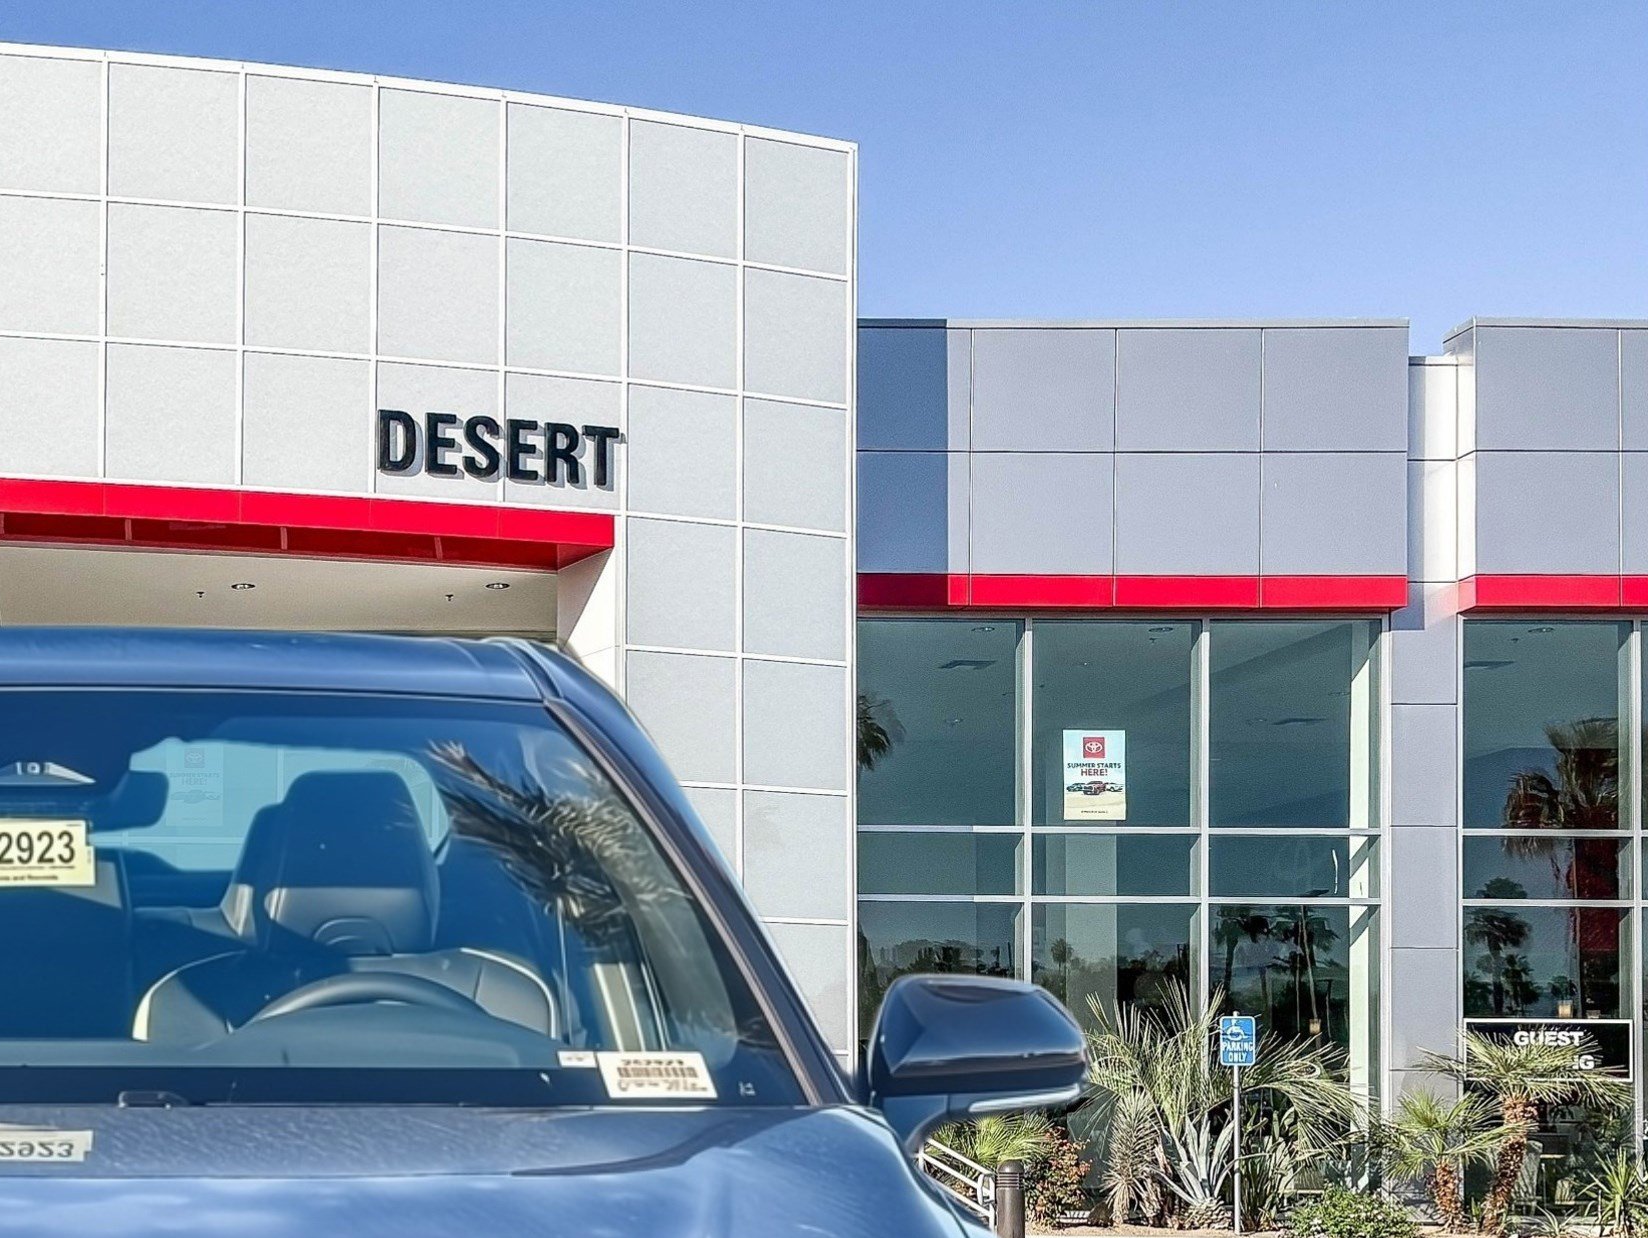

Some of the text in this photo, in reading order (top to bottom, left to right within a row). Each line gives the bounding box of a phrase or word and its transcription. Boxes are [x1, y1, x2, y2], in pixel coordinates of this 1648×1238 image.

[377, 409, 620, 487] DESERT
[1080, 768, 1108, 776] HERE!
[1513, 1030, 1584, 1046] GUEST
[1221, 1041, 1254, 1052] PARKING
[1228, 1051, 1247, 1062] ONLY
